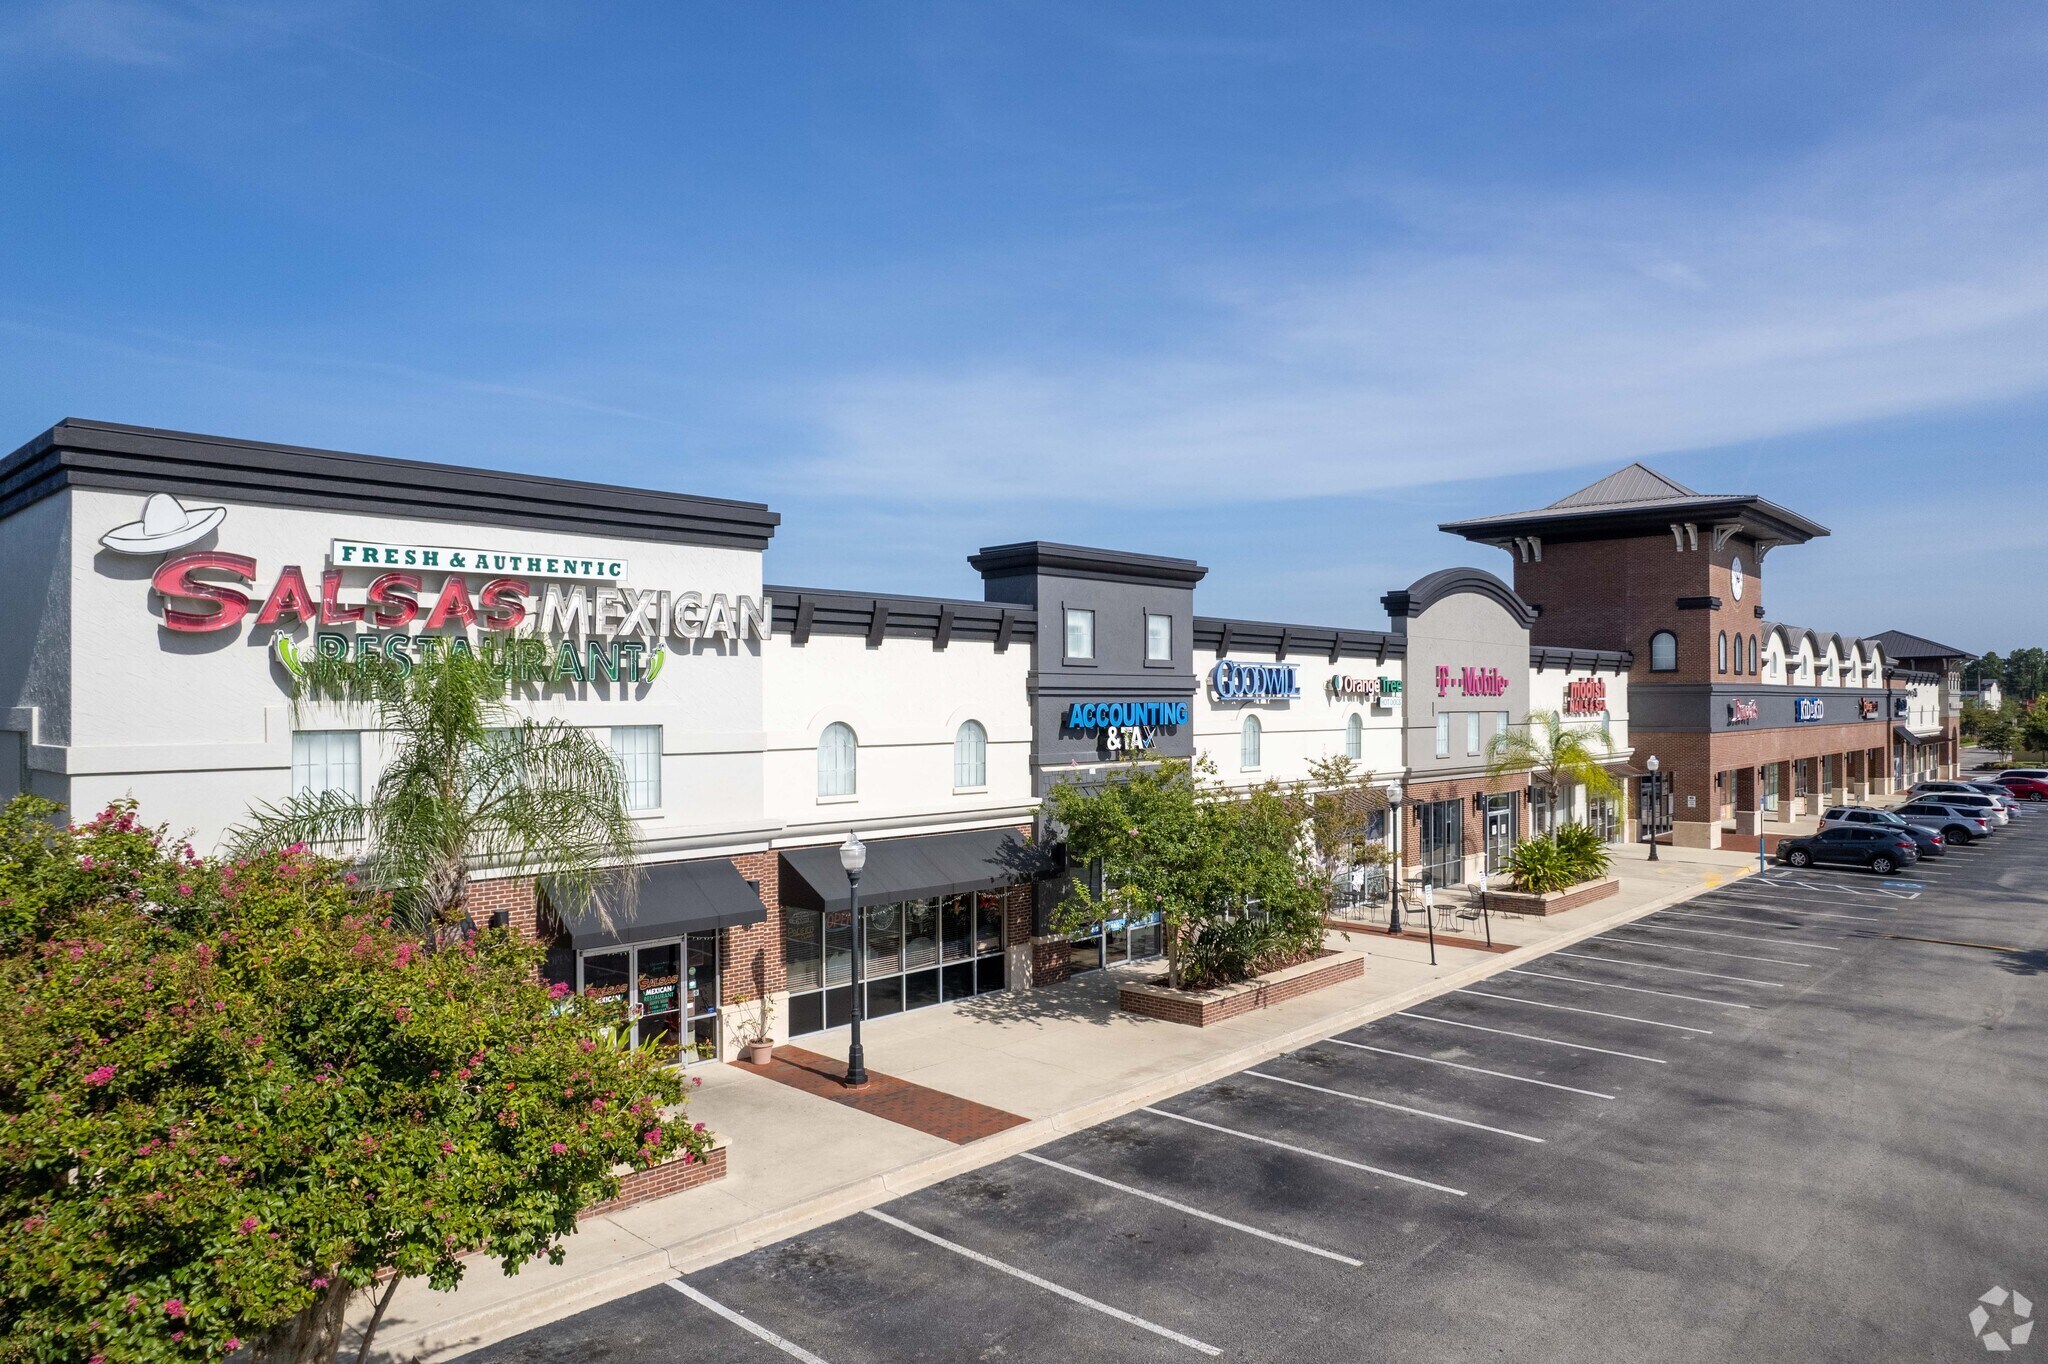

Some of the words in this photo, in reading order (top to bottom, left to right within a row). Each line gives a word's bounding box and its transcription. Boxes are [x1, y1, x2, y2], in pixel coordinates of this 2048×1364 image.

[341, 545, 439, 566] FRESH
[449, 552, 467, 568] &
[475, 554, 622, 577] AUTHENTIC
[151, 550, 530, 632] SALSAS
[535, 582, 772, 641] MEXICAN
[1343, 675, 1380, 696] Orange
[1379, 676, 1403, 693] Tree
[1069, 701, 1189, 729] ACCOUNTING
[1569, 699, 1588, 713] NAILS
[1106, 726, 1121, 751] &
[1120, 726, 1157, 751] TAX
[645, 985, 672, 996] MEXICAN
